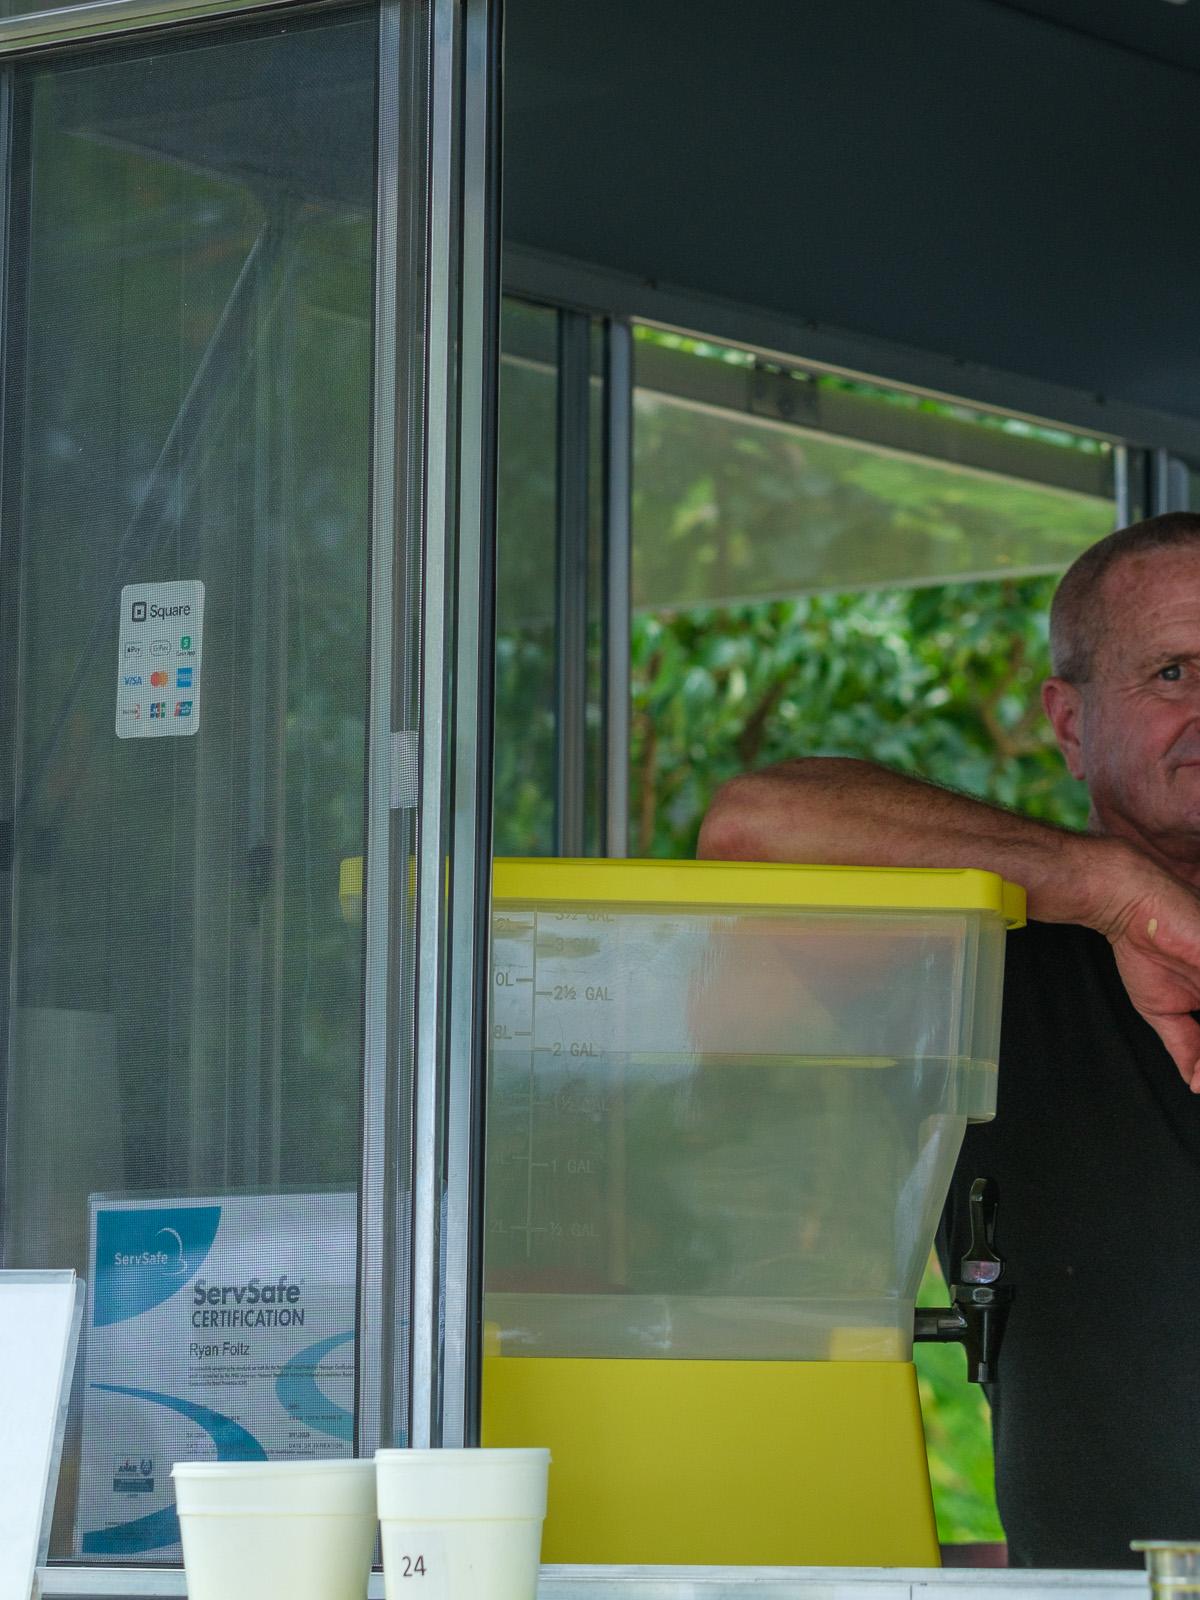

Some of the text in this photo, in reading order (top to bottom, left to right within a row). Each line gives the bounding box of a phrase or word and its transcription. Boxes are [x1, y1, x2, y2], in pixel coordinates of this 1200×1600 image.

[149, 604, 191, 620] Square
[124, 676, 142, 686] VISA
[585, 986, 614, 1000] GAL
[553, 1042, 598, 1057] 2 GAL
[567, 1160, 594, 1173] GAL
[570, 1223, 600, 1237] GAL
[114, 1251, 168, 1265] ServSafe
[193, 1275, 300, 1306] ServSafe
[191, 1308, 304, 1328] CERTIFICATION
[189, 1341, 250, 1359] Ryan Foltz
[402, 1555, 427, 1577] 24
